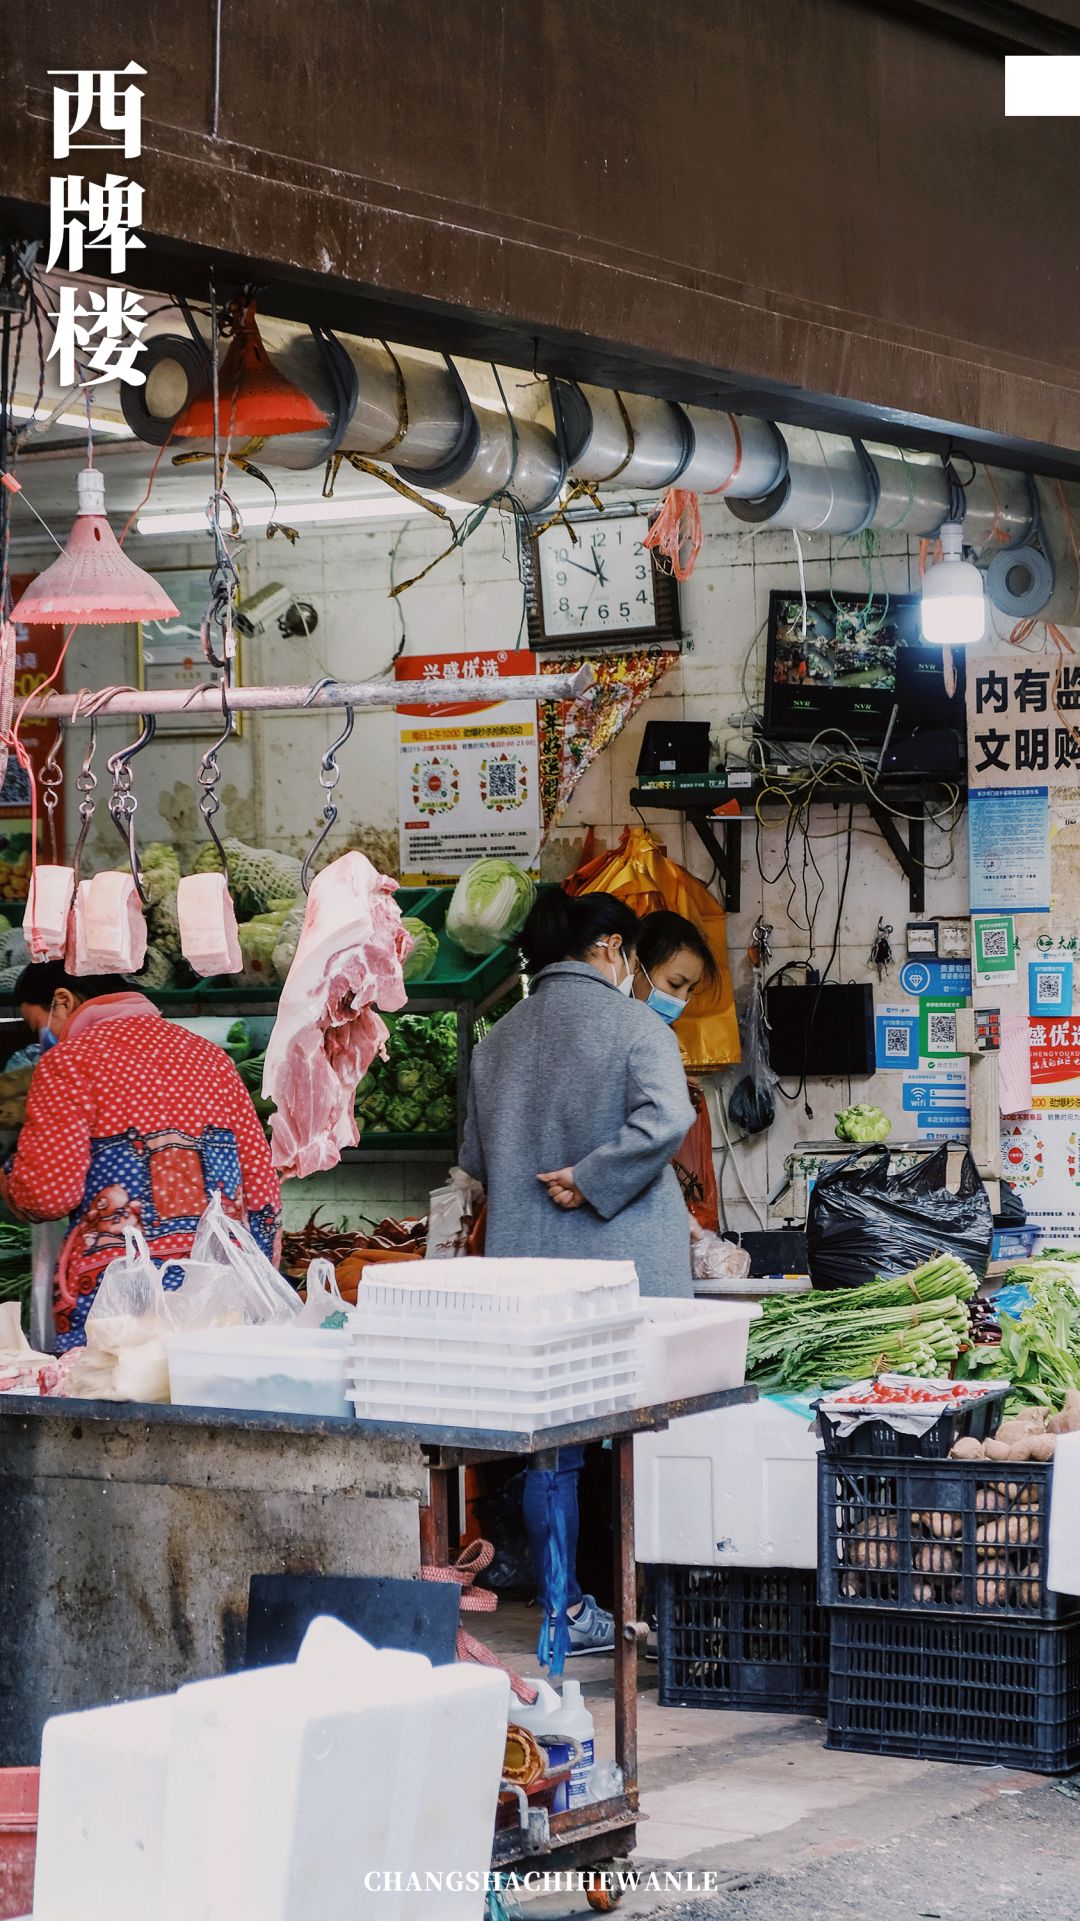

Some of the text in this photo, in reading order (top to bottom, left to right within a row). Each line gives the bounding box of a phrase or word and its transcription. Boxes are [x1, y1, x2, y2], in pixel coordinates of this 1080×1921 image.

[592, 533, 606, 547] 12
[616, 531, 622, 544] 1
[555, 548, 569, 562] 10
[633, 541, 645, 556] 2
[557, 572, 567, 586] 9
[635, 565, 646, 580] 3
[559, 597, 570, 612] 8
[635, 590, 648, 604] 4
[578, 606, 588, 621] 7
[598, 604, 609, 619] 6
[620, 602, 630, 617] 5
[423, 656, 499, 680] 兴盛优选
[975, 667, 1080, 714] 内有监
[910, 1099, 927, 1107] wifi
[593, 1621, 611, 1638] N
